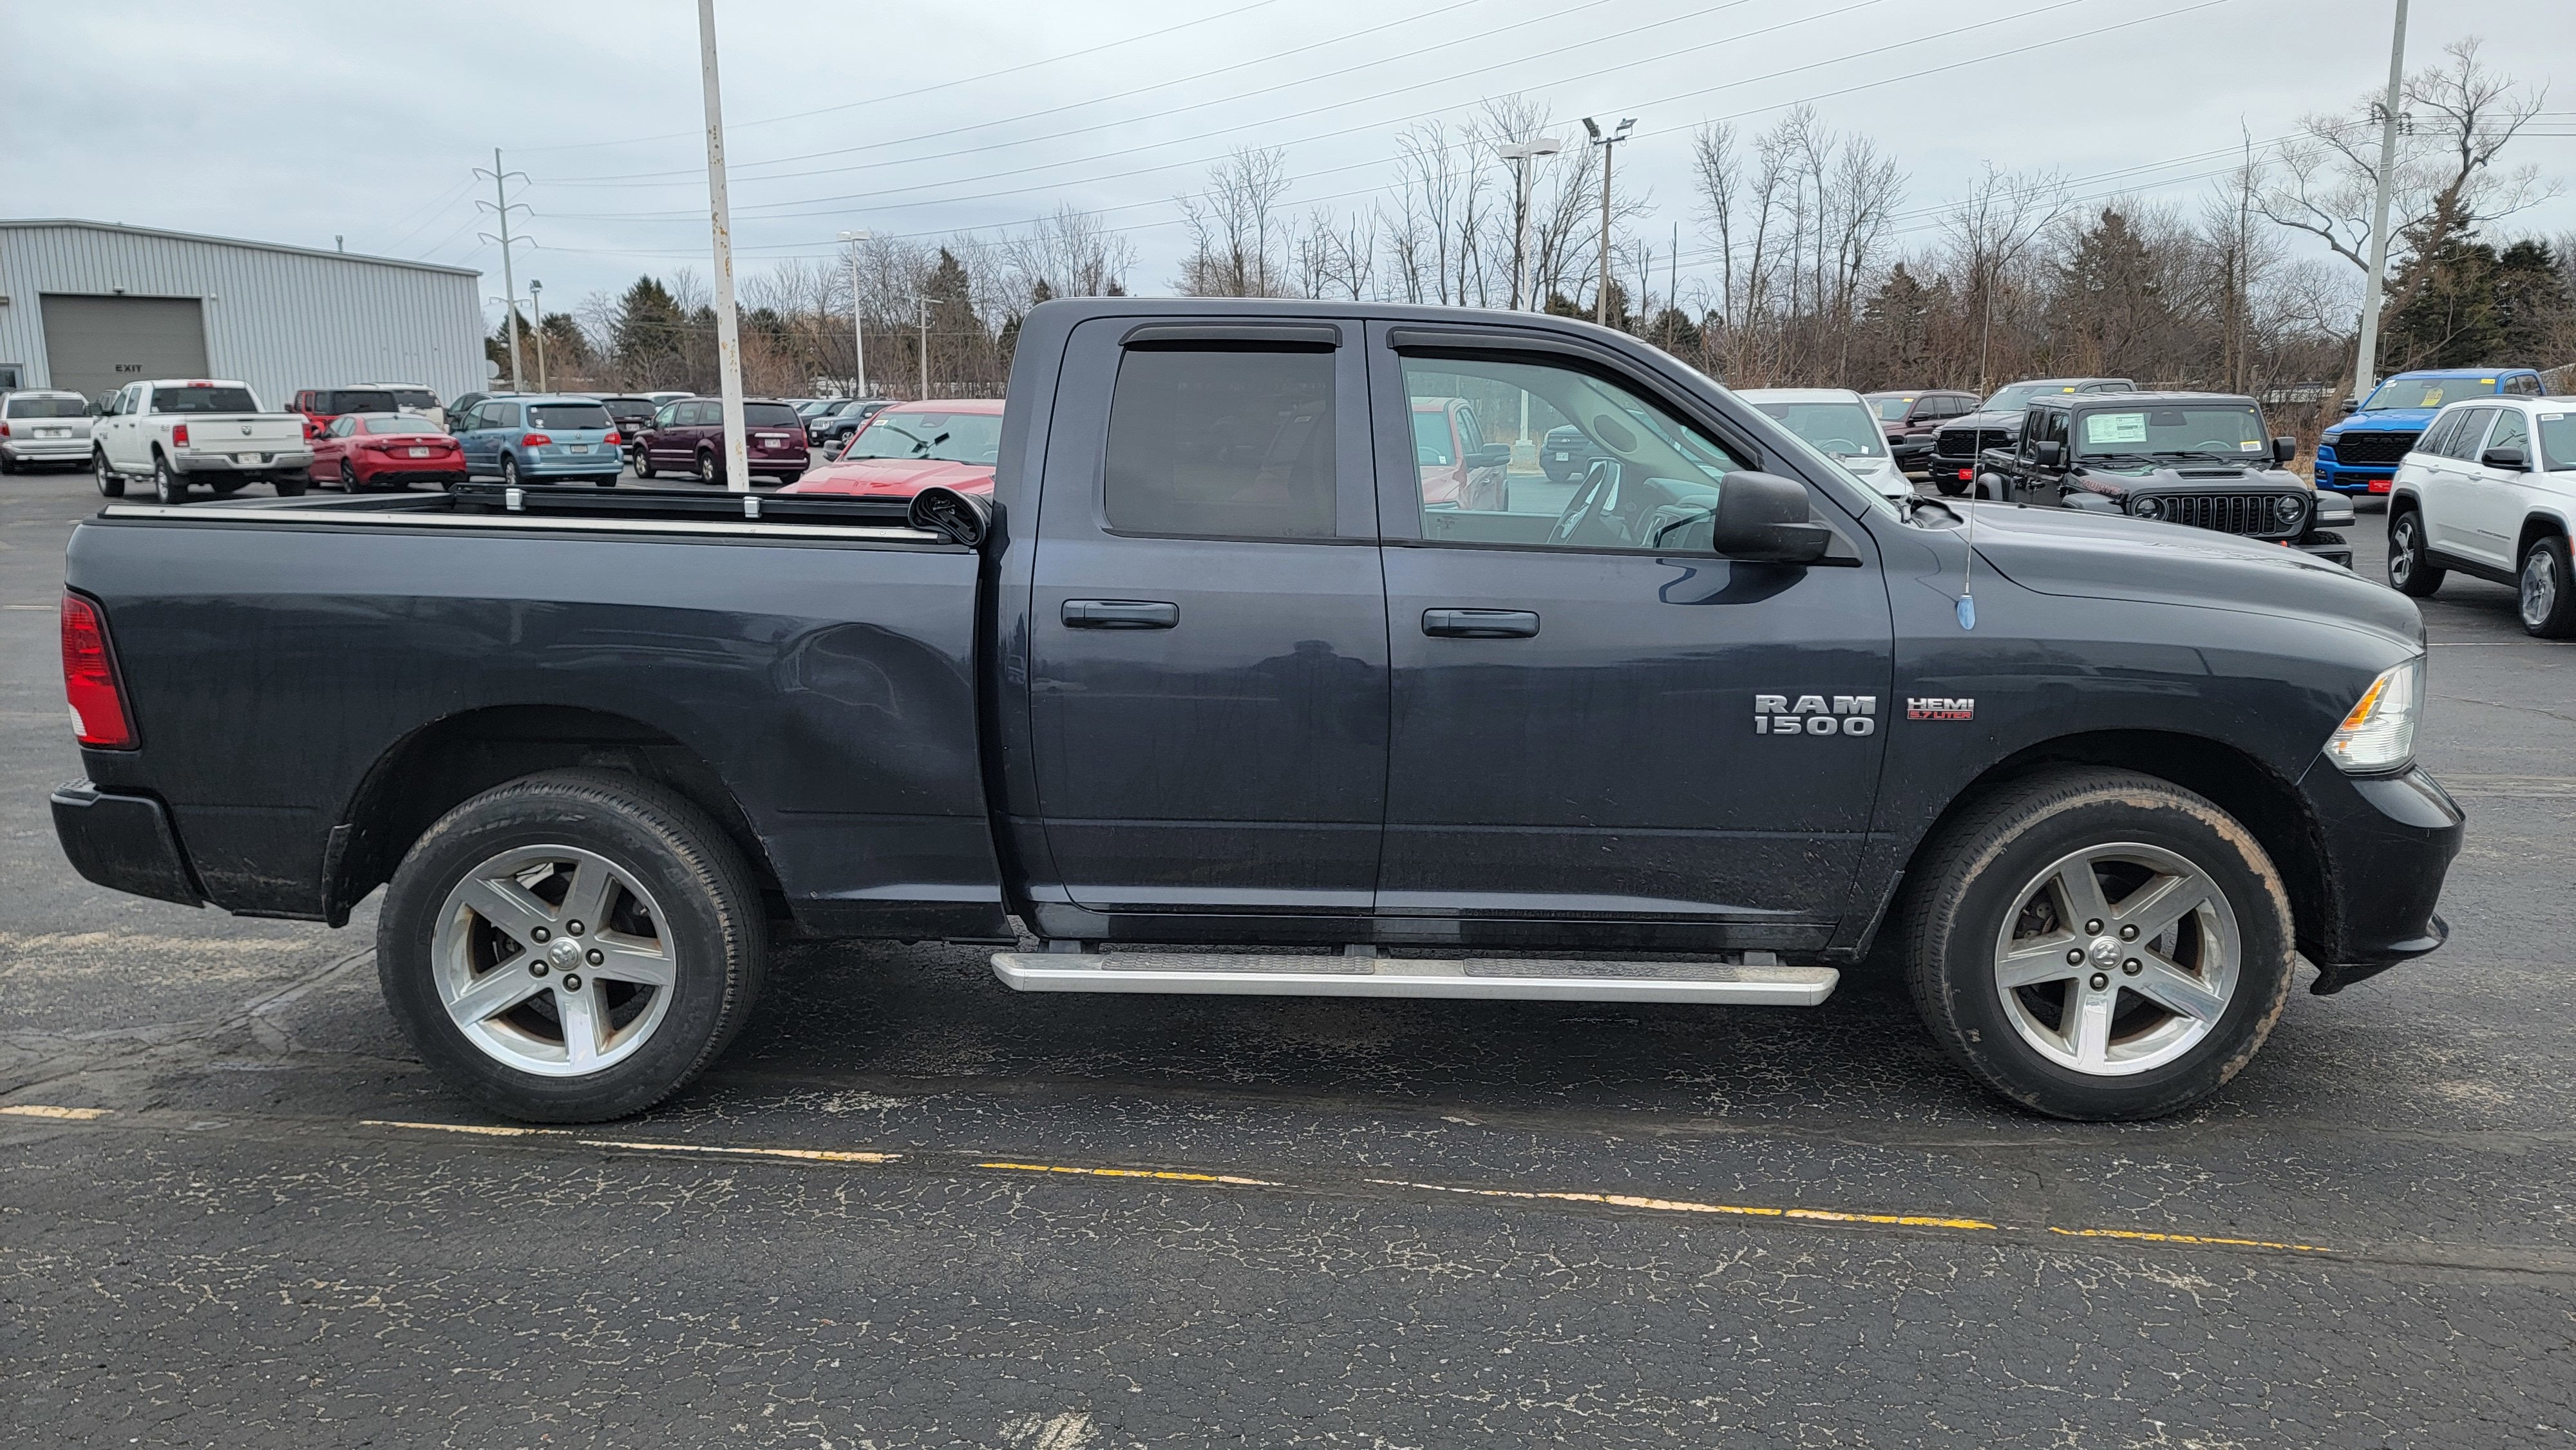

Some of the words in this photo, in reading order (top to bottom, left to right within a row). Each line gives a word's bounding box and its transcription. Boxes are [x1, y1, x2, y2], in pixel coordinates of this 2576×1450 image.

[2081, 479, 2121, 495] MOJAVE
[1755, 695, 1877, 715] RAM
[1907, 698, 1975, 710] HEMI
[1933, 711, 1971, 719] LITER
[1754, 716, 1875, 736] 1500
